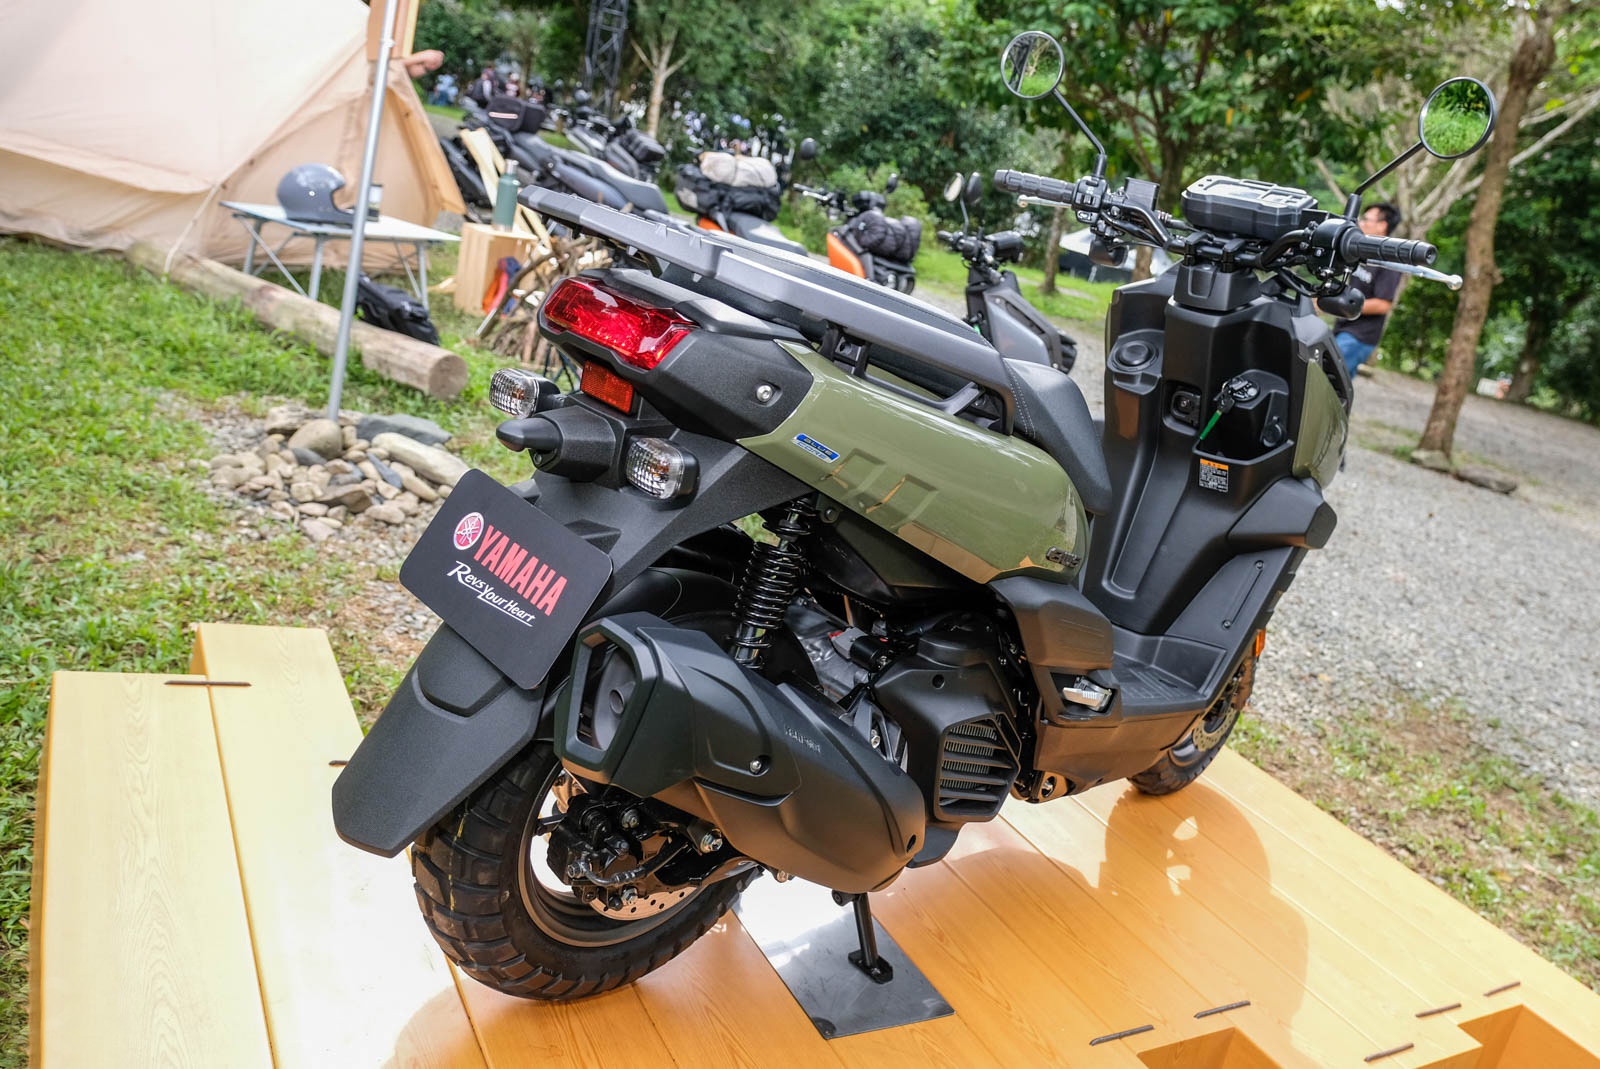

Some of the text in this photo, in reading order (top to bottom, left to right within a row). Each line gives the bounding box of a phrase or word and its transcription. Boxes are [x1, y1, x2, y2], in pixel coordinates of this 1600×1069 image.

[797, 441, 827, 460] CORE
[803, 437, 833, 456] BLUE
[473, 524, 568, 617] YAMAHA
[446, 560, 536, 623] Revs Your Heart
